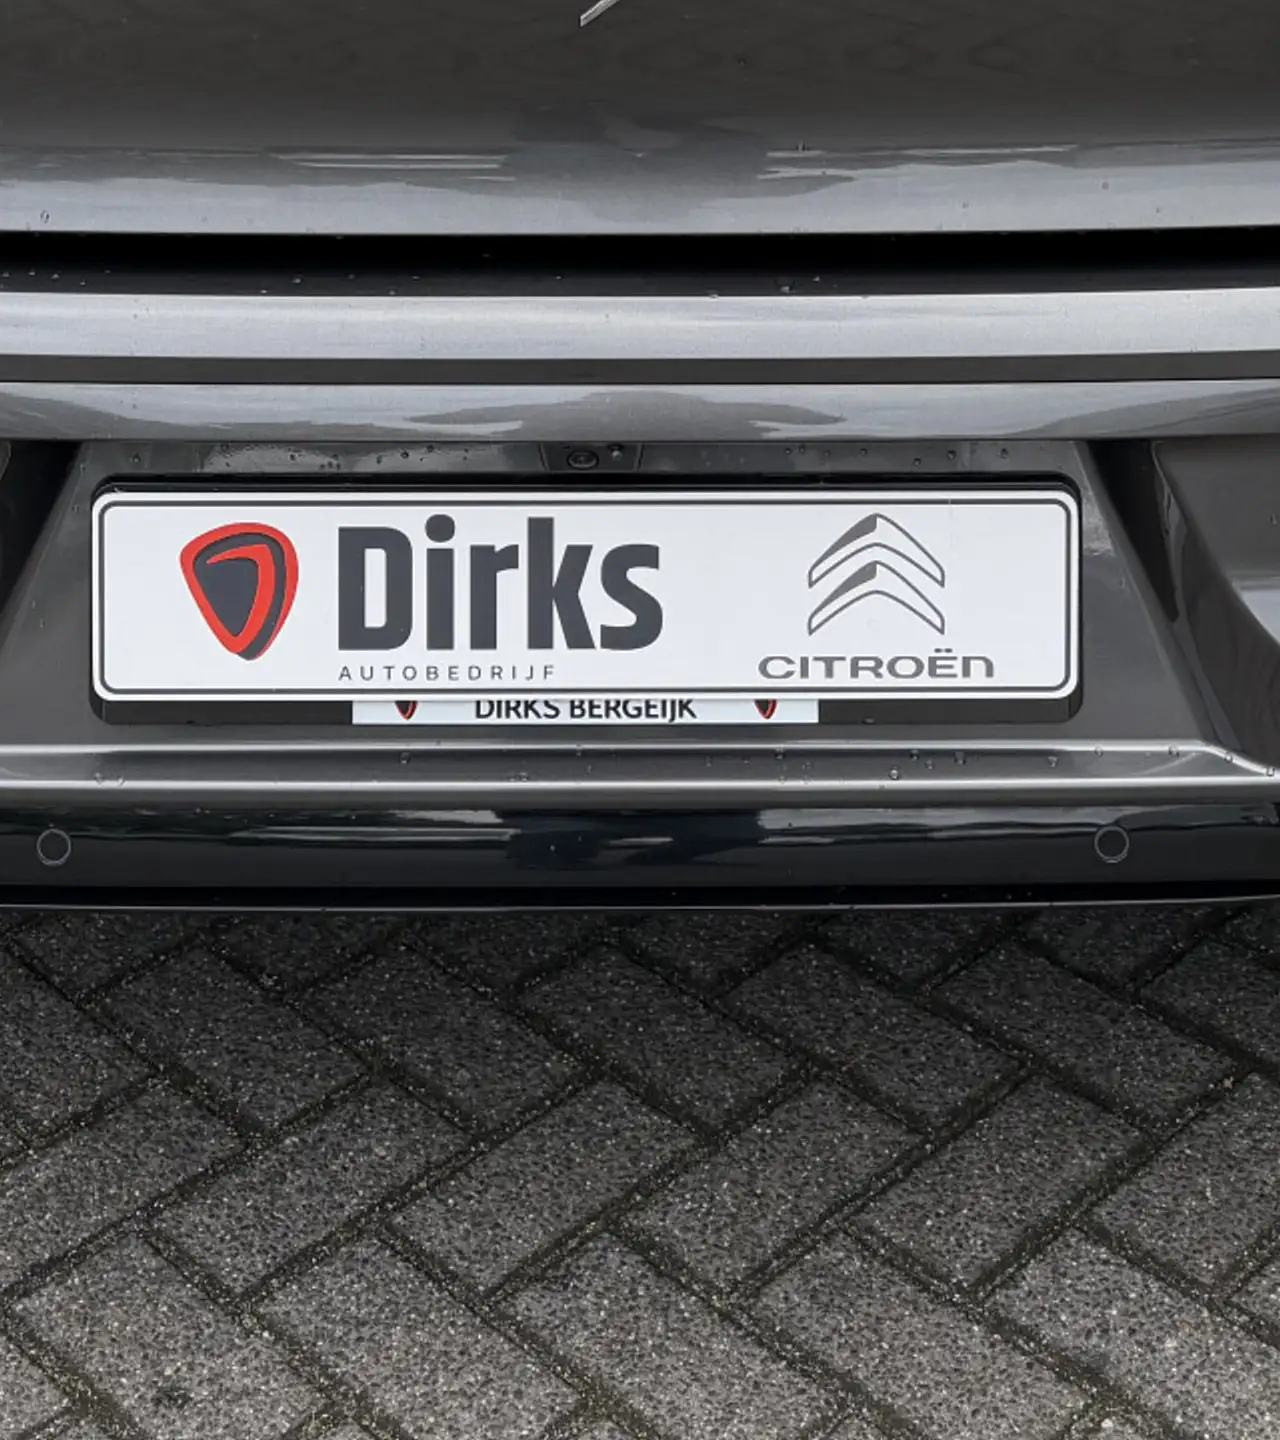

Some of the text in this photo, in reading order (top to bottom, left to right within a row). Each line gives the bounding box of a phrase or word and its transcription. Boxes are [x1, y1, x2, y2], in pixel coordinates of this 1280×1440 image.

[337, 513, 664, 651] Dirks
[337, 664, 557, 681] AUTOBEDRIJF
[475, 700, 698, 723] DIRKS BERGEIJK
